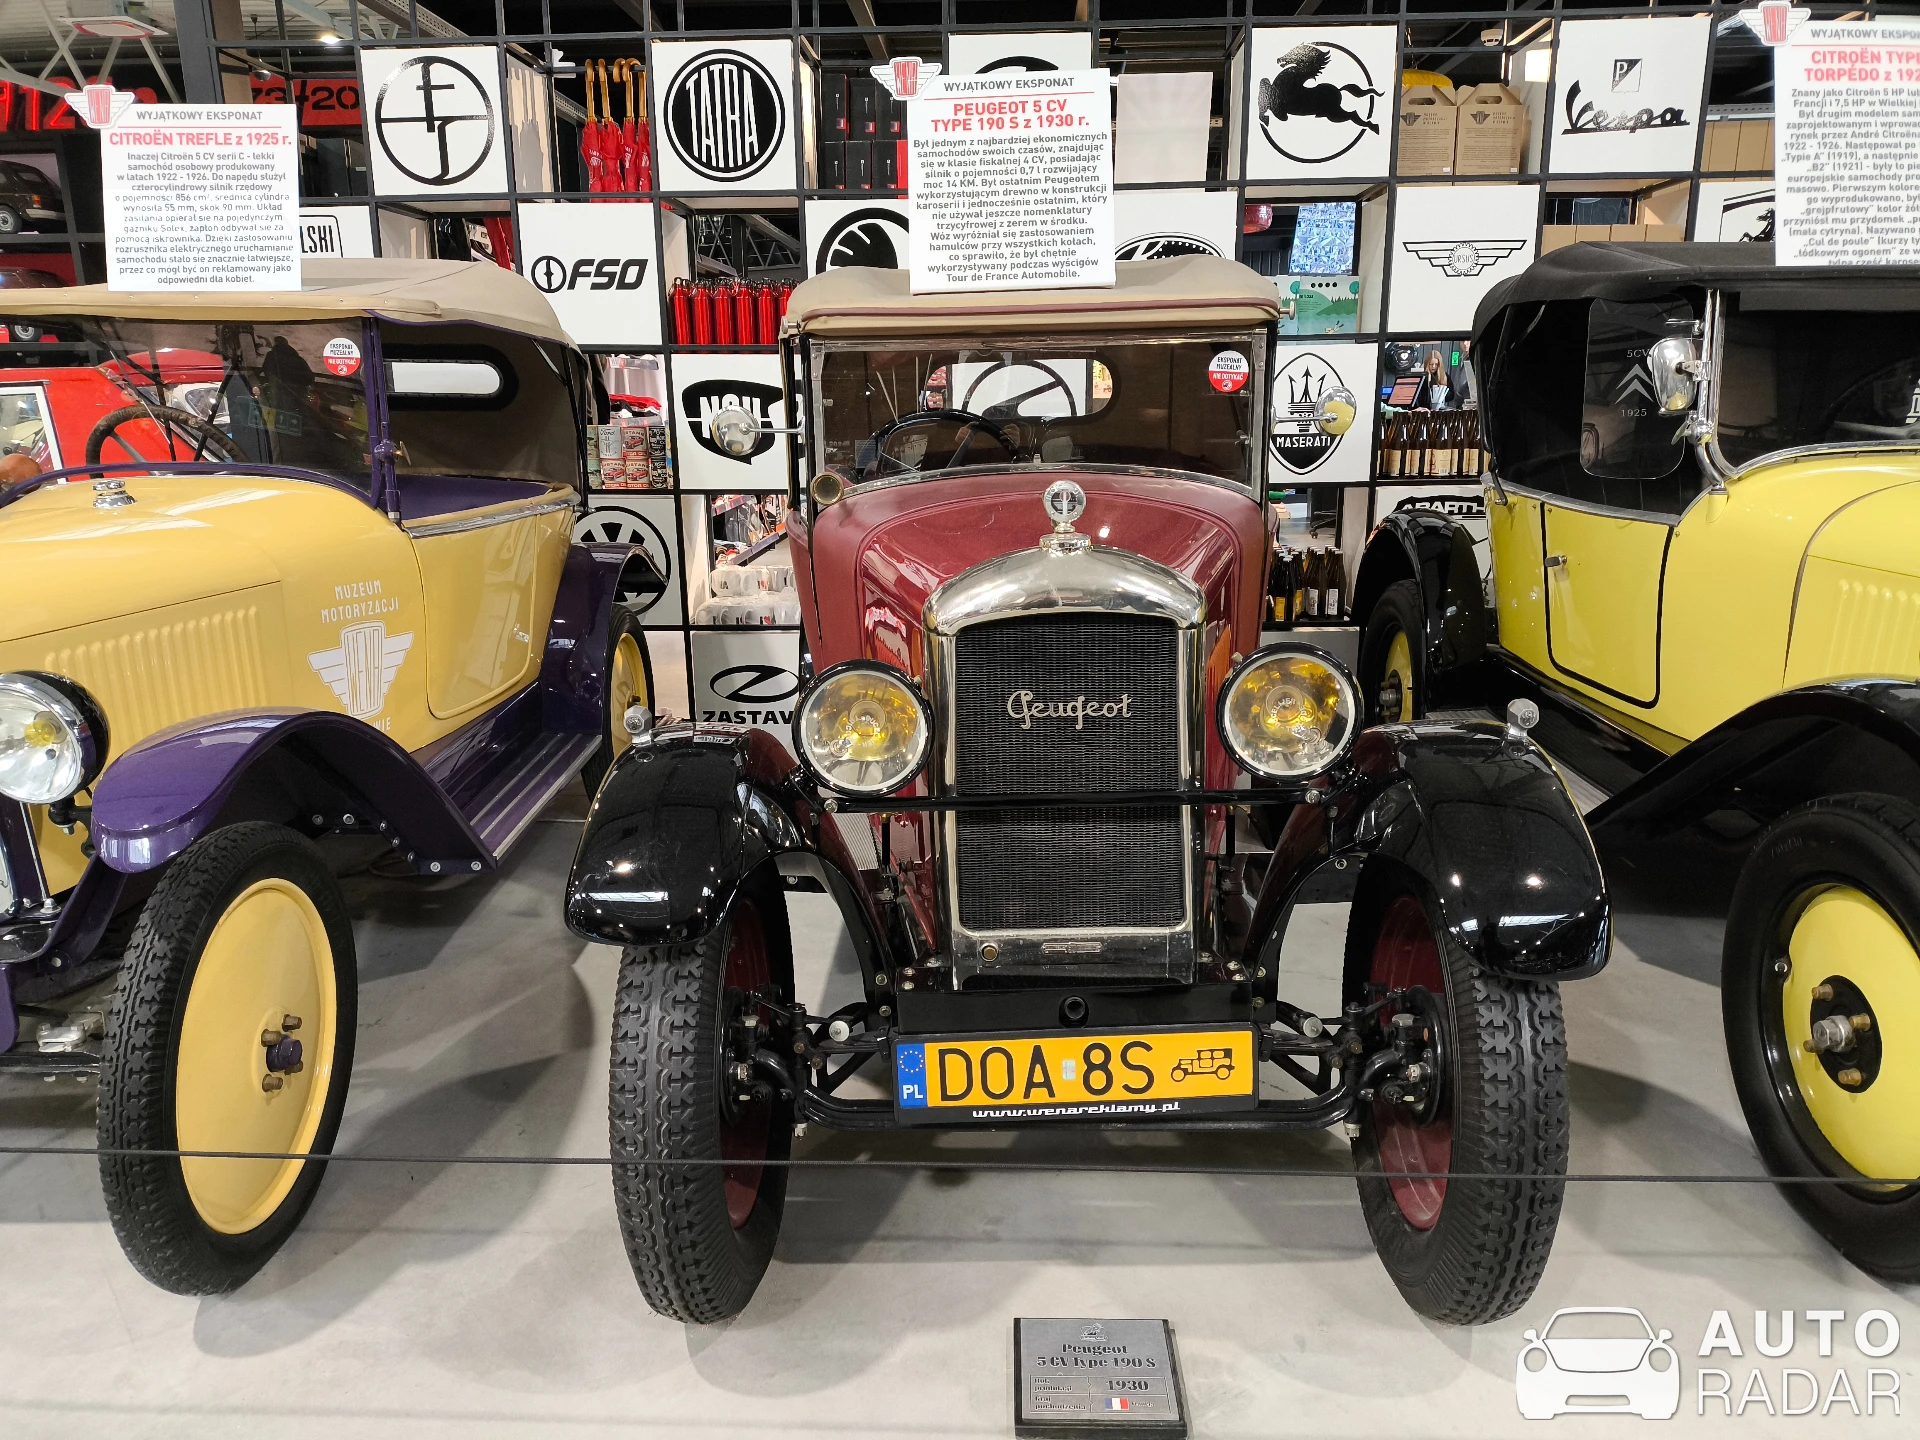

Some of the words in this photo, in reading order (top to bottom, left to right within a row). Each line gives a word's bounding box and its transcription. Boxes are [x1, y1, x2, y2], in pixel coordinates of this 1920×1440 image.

[1810, 28, 1877, 40] WYJĄTKOWY
[1881, 28, 1920, 40] EKSPO
[1811, 48, 1881, 65] CITROËN
[1804, 65, 1879, 81] TORPÉDO
[1884, 71, 1891, 80] z
[1897, 65, 1920, 82] 192
[943, 80, 1012, 92] WYJĄTKOWY
[1015, 77, 1074, 88] EKSPONAT
[1791, 88, 1820, 98] Znany
[1822, 88, 1843, 98] jako
[1845, 87, 1880, 96] Citroën
[1883, 87, 1888, 96] 5
[1891, 88, 1904, 96] HP
[953, 100, 1028, 116] PEUGEOT
[1033, 100, 1041, 112] 5
[1046, 98, 1066, 112] CV
[1561, 79, 1690, 135] Vespa
[136, 110, 203, 122] WYJĄTKOWY
[206, 111, 262, 120] EKSPONAT
[686, 64, 759, 168] TATRA
[930, 118, 971, 132] TYPE
[977, 116, 1004, 130] 190
[1009, 116, 1018, 128] S
[1023, 118, 1031, 128] z
[1036, 114, 1073, 127] 1930
[1078, 116, 1089, 125] r.
[109, 129, 172, 145] CITROËN
[176, 132, 232, 145] TREFLE
[235, 135, 242, 145] z
[246, 132, 278, 145] 1925
[282, 135, 291, 144] r.
[913, 139, 929, 149] Był
[931, 137, 966, 148] jednym
[977, 135, 1030, 147] najbardziej
[1033, 131, 1107, 144] ekonomicznych
[917, 146, 979, 157] samochodów
[982, 145, 1015, 155] swoich
[1017, 144, 1055, 154] czasów,
[1058, 142, 1103, 154] znajdując
[127, 162, 172, 173] samochód
[175, 162, 213, 173] osobowy
[215, 162, 274, 172] produkowany
[131, 183, 207, 194] czterocylindrowy
[209, 182, 233, 190] silnik
[235, 182, 272, 193] rzędowy
[916, 188, 999, 201] wykorzystującym
[1002, 187, 1038, 196] drewno
[1052, 184, 1106, 195] konstrukcji
[916, 200, 959, 209] karoserii
[962, 200, 965, 208] i
[967, 197, 1030, 209] jednocześnie
[1033, 195, 1078, 205] ostatnim,
[1081, 194, 1107, 204] który
[932, 210, 946, 219] nie
[949, 209, 983, 220] używał
[984, 208, 1020, 219] jeszcze
[1023, 206, 1092, 218] nomenklatury
[936, 219, 996, 231] trzycyfrowej
[1006, 219, 1037, 227] zerem
[1050, 216, 1087, 225] środku.
[300, 225, 334, 253] LSKI
[930, 231, 950, 240] Wóz
[952, 229, 999, 241] wyróżniał
[1002, 229, 1016, 239] się
[1019, 226, 1094, 237] zastosowaniem
[929, 240, 978, 251] hamulców
[1004, 238, 1057, 249] wszystkich
[1060, 237, 1095, 246] kołach,
[962, 250, 1007, 262] sprawiło,
[1009, 250, 1020, 258] że
[1023, 249, 1038, 259] był
[1040, 248, 1076, 259] chętnie
[1455, 254, 1475, 263] URSUS
[927, 261, 1007, 273] wykorzystywany
[1010, 259, 1049, 270] podczas
[1051, 258, 1098, 268] wyścigów
[157, 275, 207, 284] odpowiedni
[225, 274, 254, 282] kobiet.
[567, 259, 648, 290] FSO
[946, 273, 968, 282] Tour
[971, 272, 982, 281] de
[985, 271, 1018, 280] France
[1021, 269, 1079, 279] Automobile.
[1277, 436, 1330, 447] MASERATI
[335, 580, 382, 600] MUZEUM
[321, 597, 399, 623] MOTORYZACJI
[1007, 690, 1131, 729] Peugeot
[703, 711, 794, 724] ZASTAV
[938, 1045, 1055, 1101] DOA
[1082, 1040, 1155, 1096] 8S
[903, 1085, 923, 1099] PL
[973, 1102, 1180, 1118] www.wenareklamy.pl
[1062, 1344, 1128, 1356] Peugeot
[1037, 1356, 1046, 1368] 5
[1050, 1356, 1069, 1368] CV
[1072, 1356, 1107, 1368] Type
[1111, 1357, 1142, 1367] 190
[1145, 1357, 1156, 1369] S
[1106, 1380, 1149, 1391] 1930
